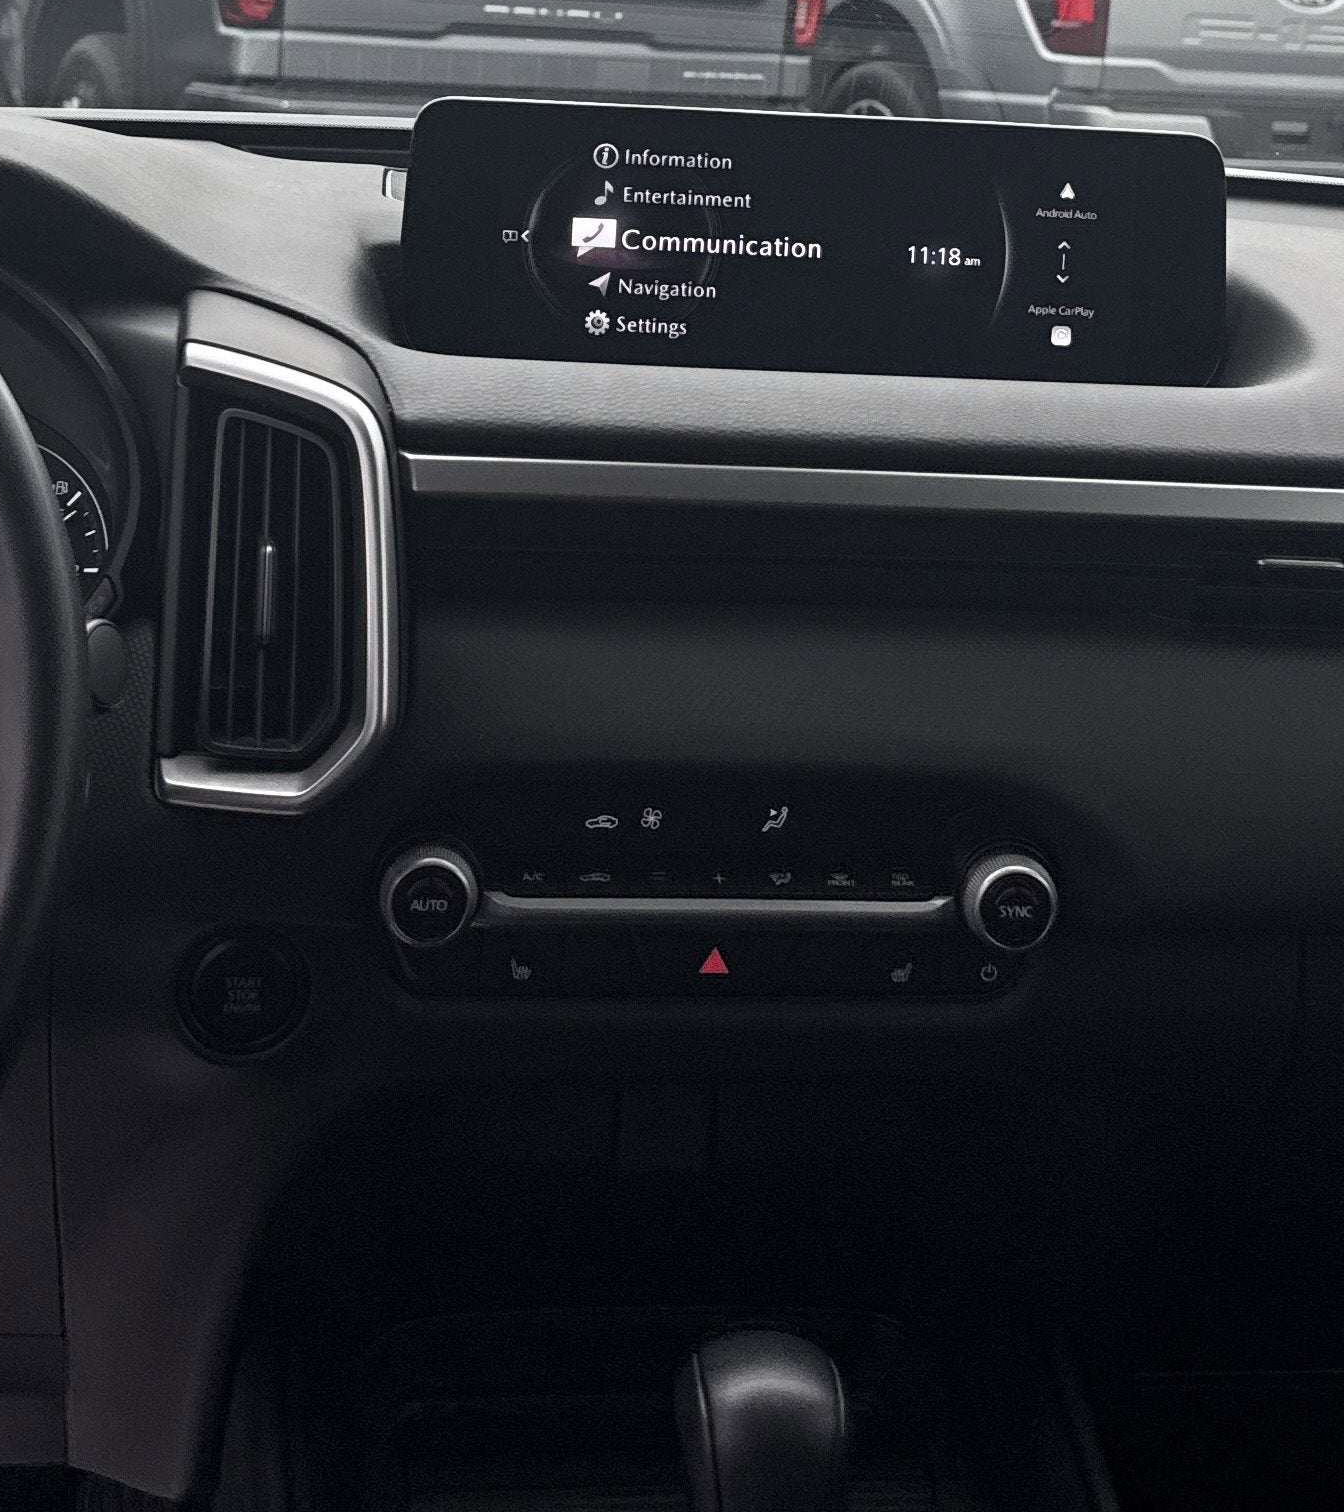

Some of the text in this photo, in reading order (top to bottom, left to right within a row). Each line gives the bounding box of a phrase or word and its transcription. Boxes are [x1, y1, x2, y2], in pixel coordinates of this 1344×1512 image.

[625, 149, 733, 169] Information
[623, 187, 752, 209] Entertainment
[1036, 208, 1098, 220] Android Auto
[621, 229, 822, 259] Communication
[908, 245, 981, 267] 11:18 am
[618, 279, 717, 301] Navigation
[1028, 304, 1095, 319] Apple CarPlay
[616, 316, 687, 339] Settings
[522, 871, 545, 882] A/C
[410, 898, 449, 912] AUTO
[999, 904, 1034, 919] SYNC
